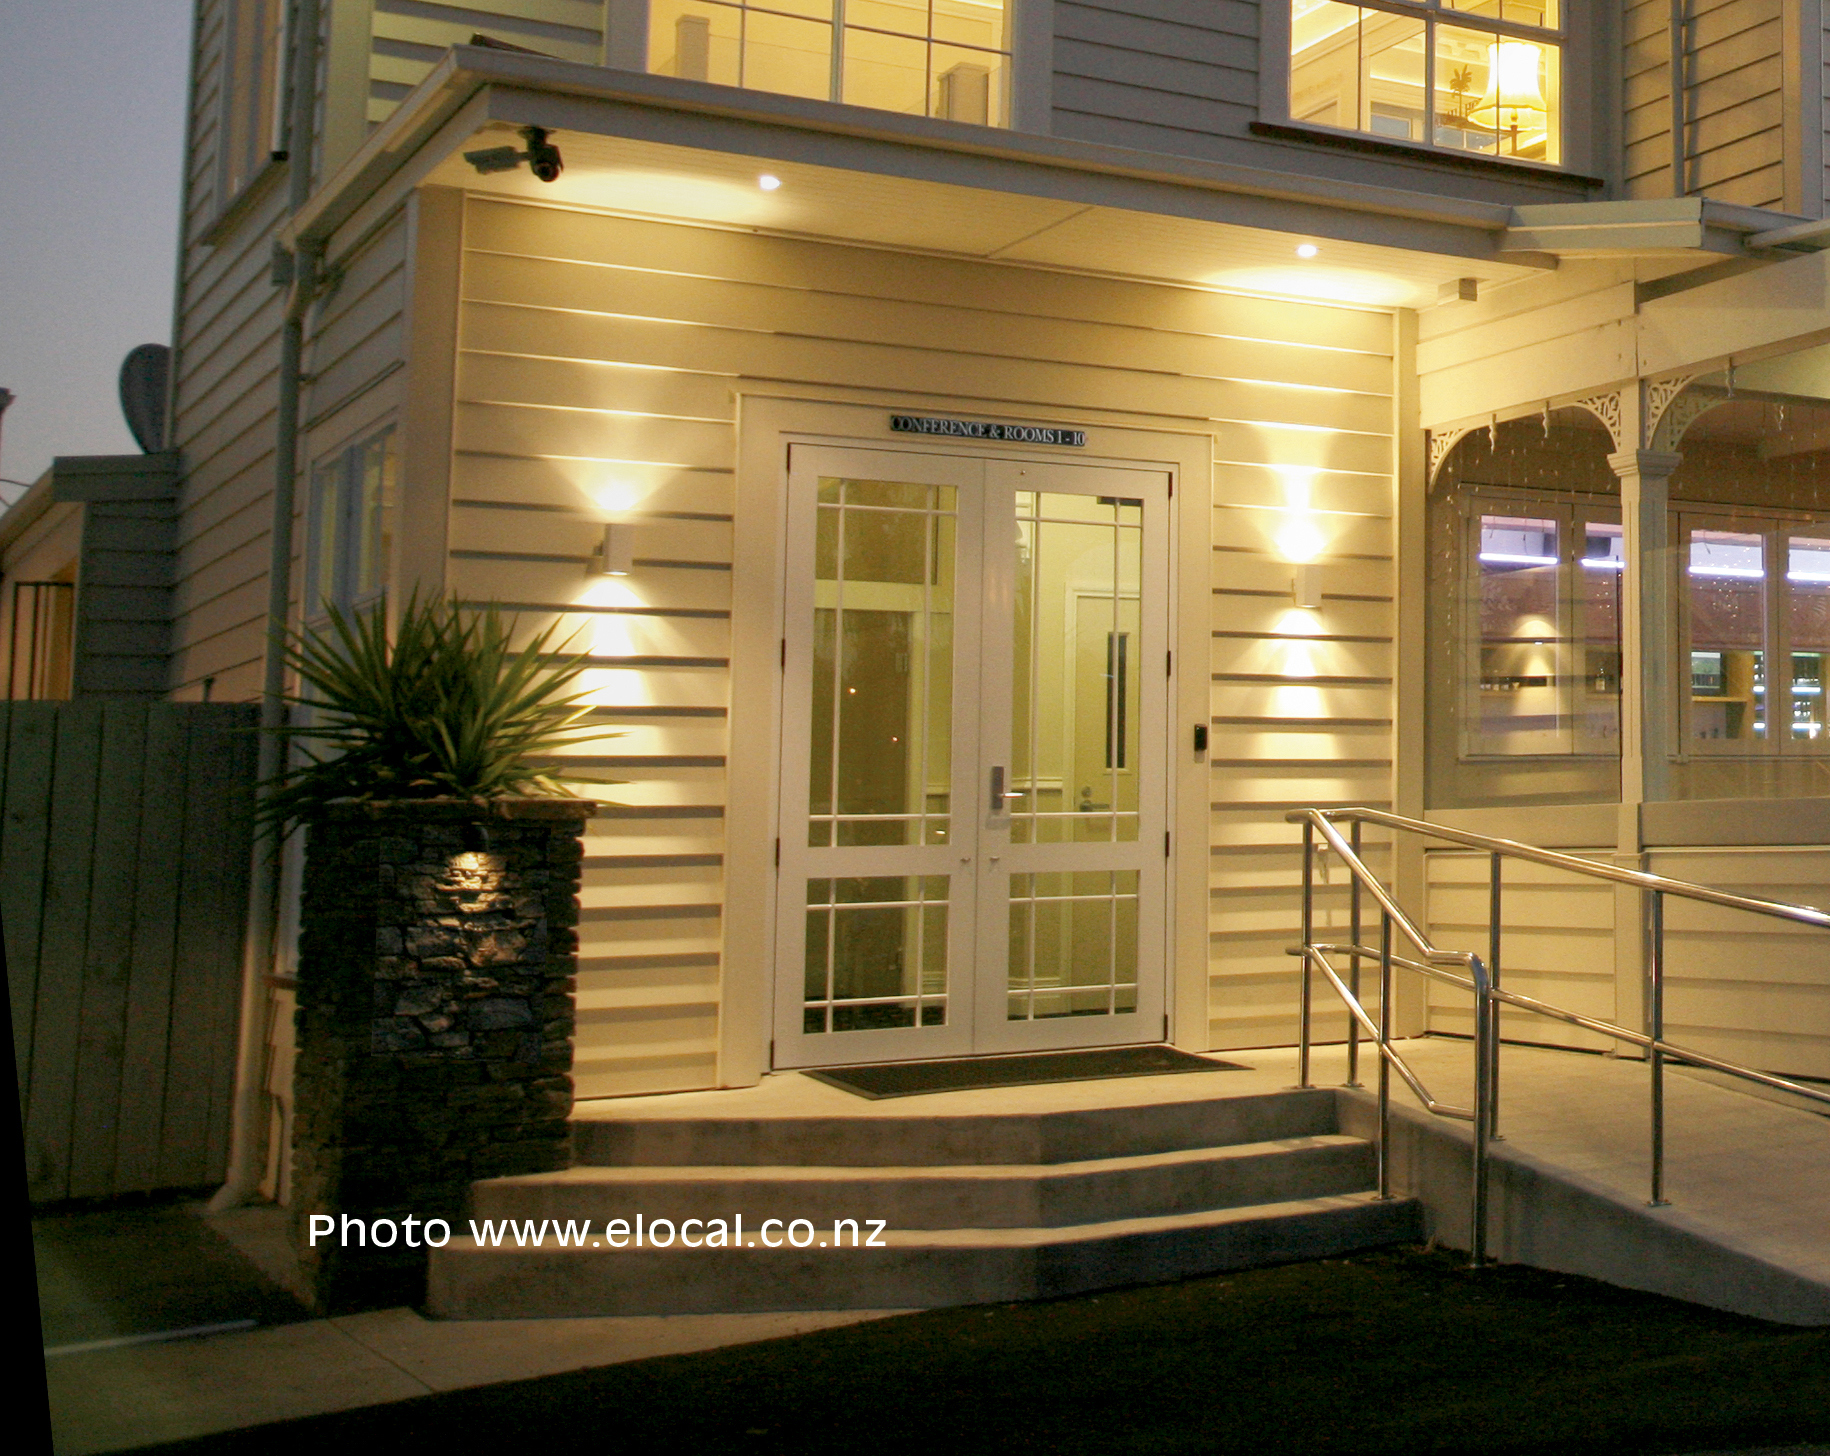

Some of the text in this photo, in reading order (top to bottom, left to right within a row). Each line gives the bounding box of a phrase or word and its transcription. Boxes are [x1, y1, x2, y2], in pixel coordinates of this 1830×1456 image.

[890, 416, 987, 438] CONFERENCE
[989, 424, 1000, 439] &
[1004, 426, 1054, 444] ROOMS
[1074, 431, 1086, 446] 10
